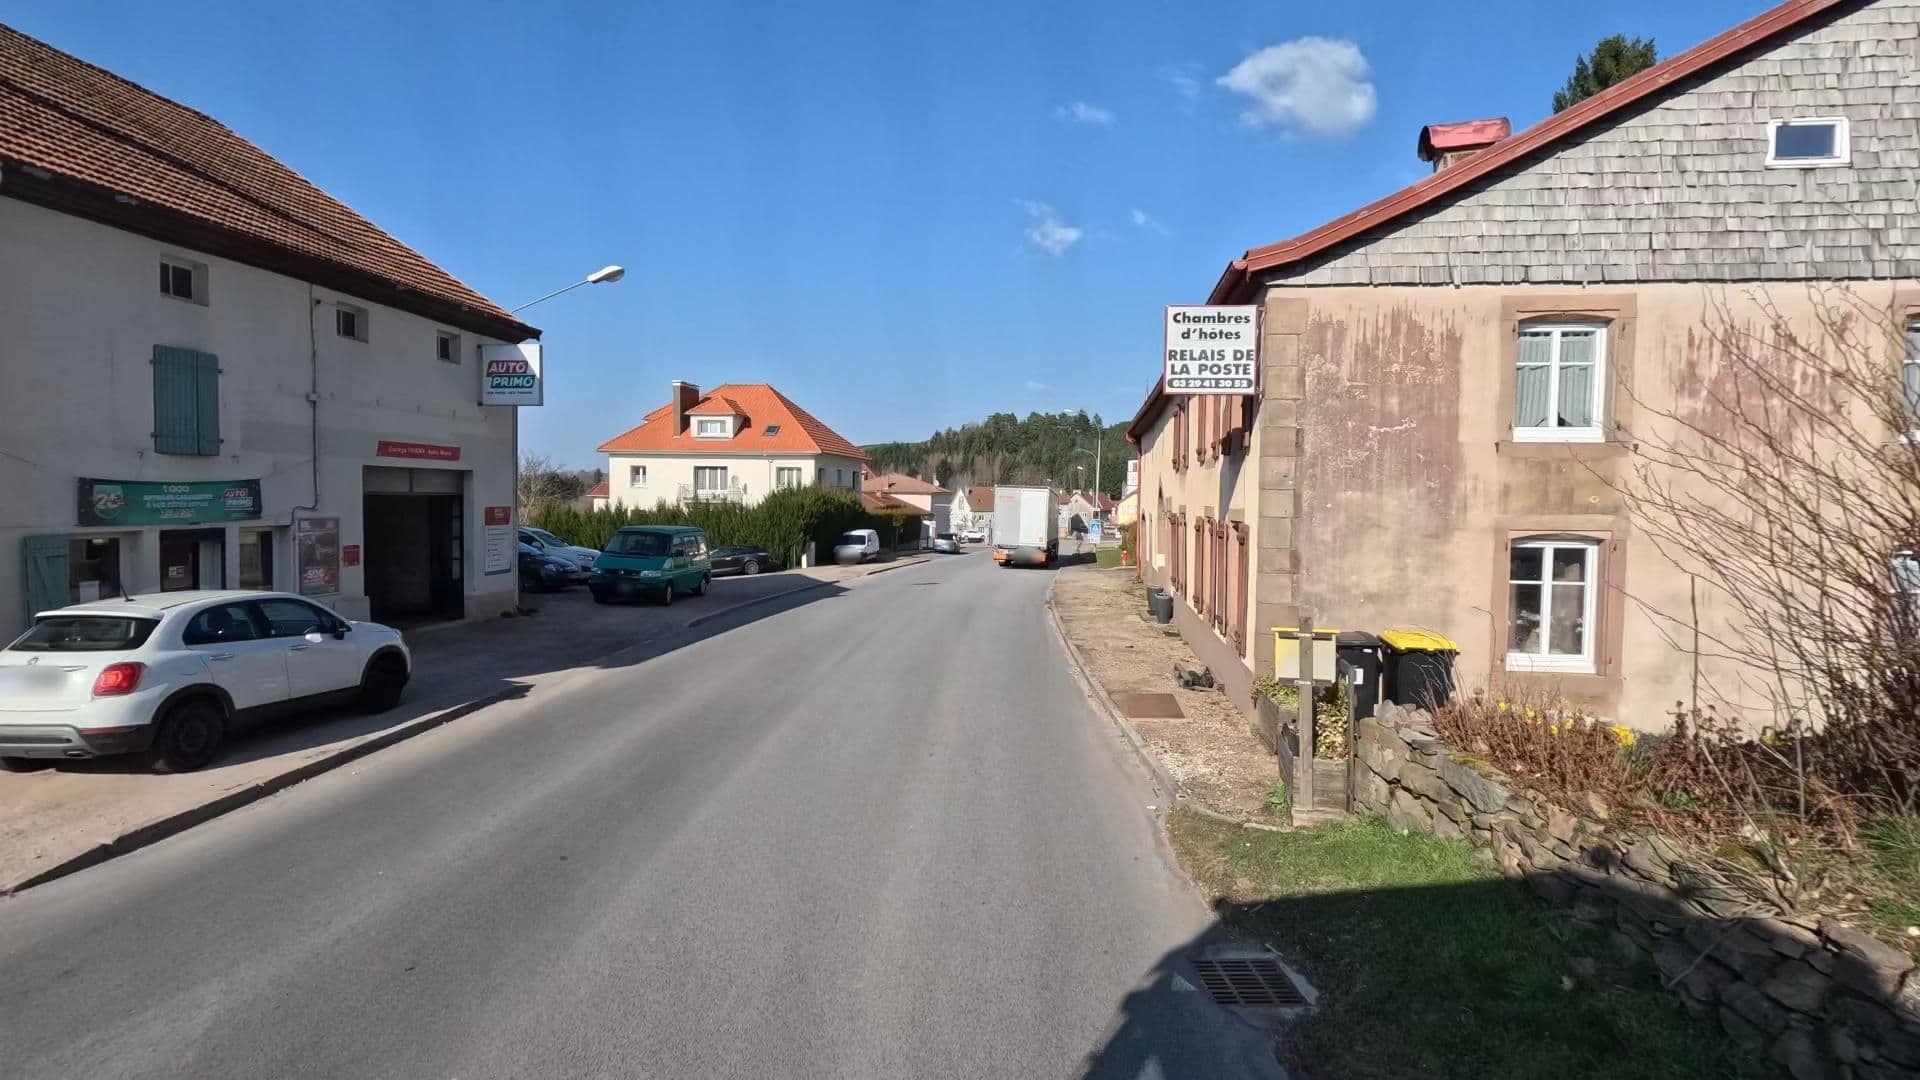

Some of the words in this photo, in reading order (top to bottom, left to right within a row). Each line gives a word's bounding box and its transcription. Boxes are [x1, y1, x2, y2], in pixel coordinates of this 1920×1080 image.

[1172, 311, 1251, 324] Chambres
[1181, 327, 1241, 340] d'hôtes
[1168, 349, 1226, 361] RELAIS
[1233, 349, 1254, 361] DE
[488, 361, 526, 373] AUTO
[1170, 363, 1191, 376] LA
[1198, 363, 1251, 376] POSTE
[492, 376, 533, 387] PRIMO
